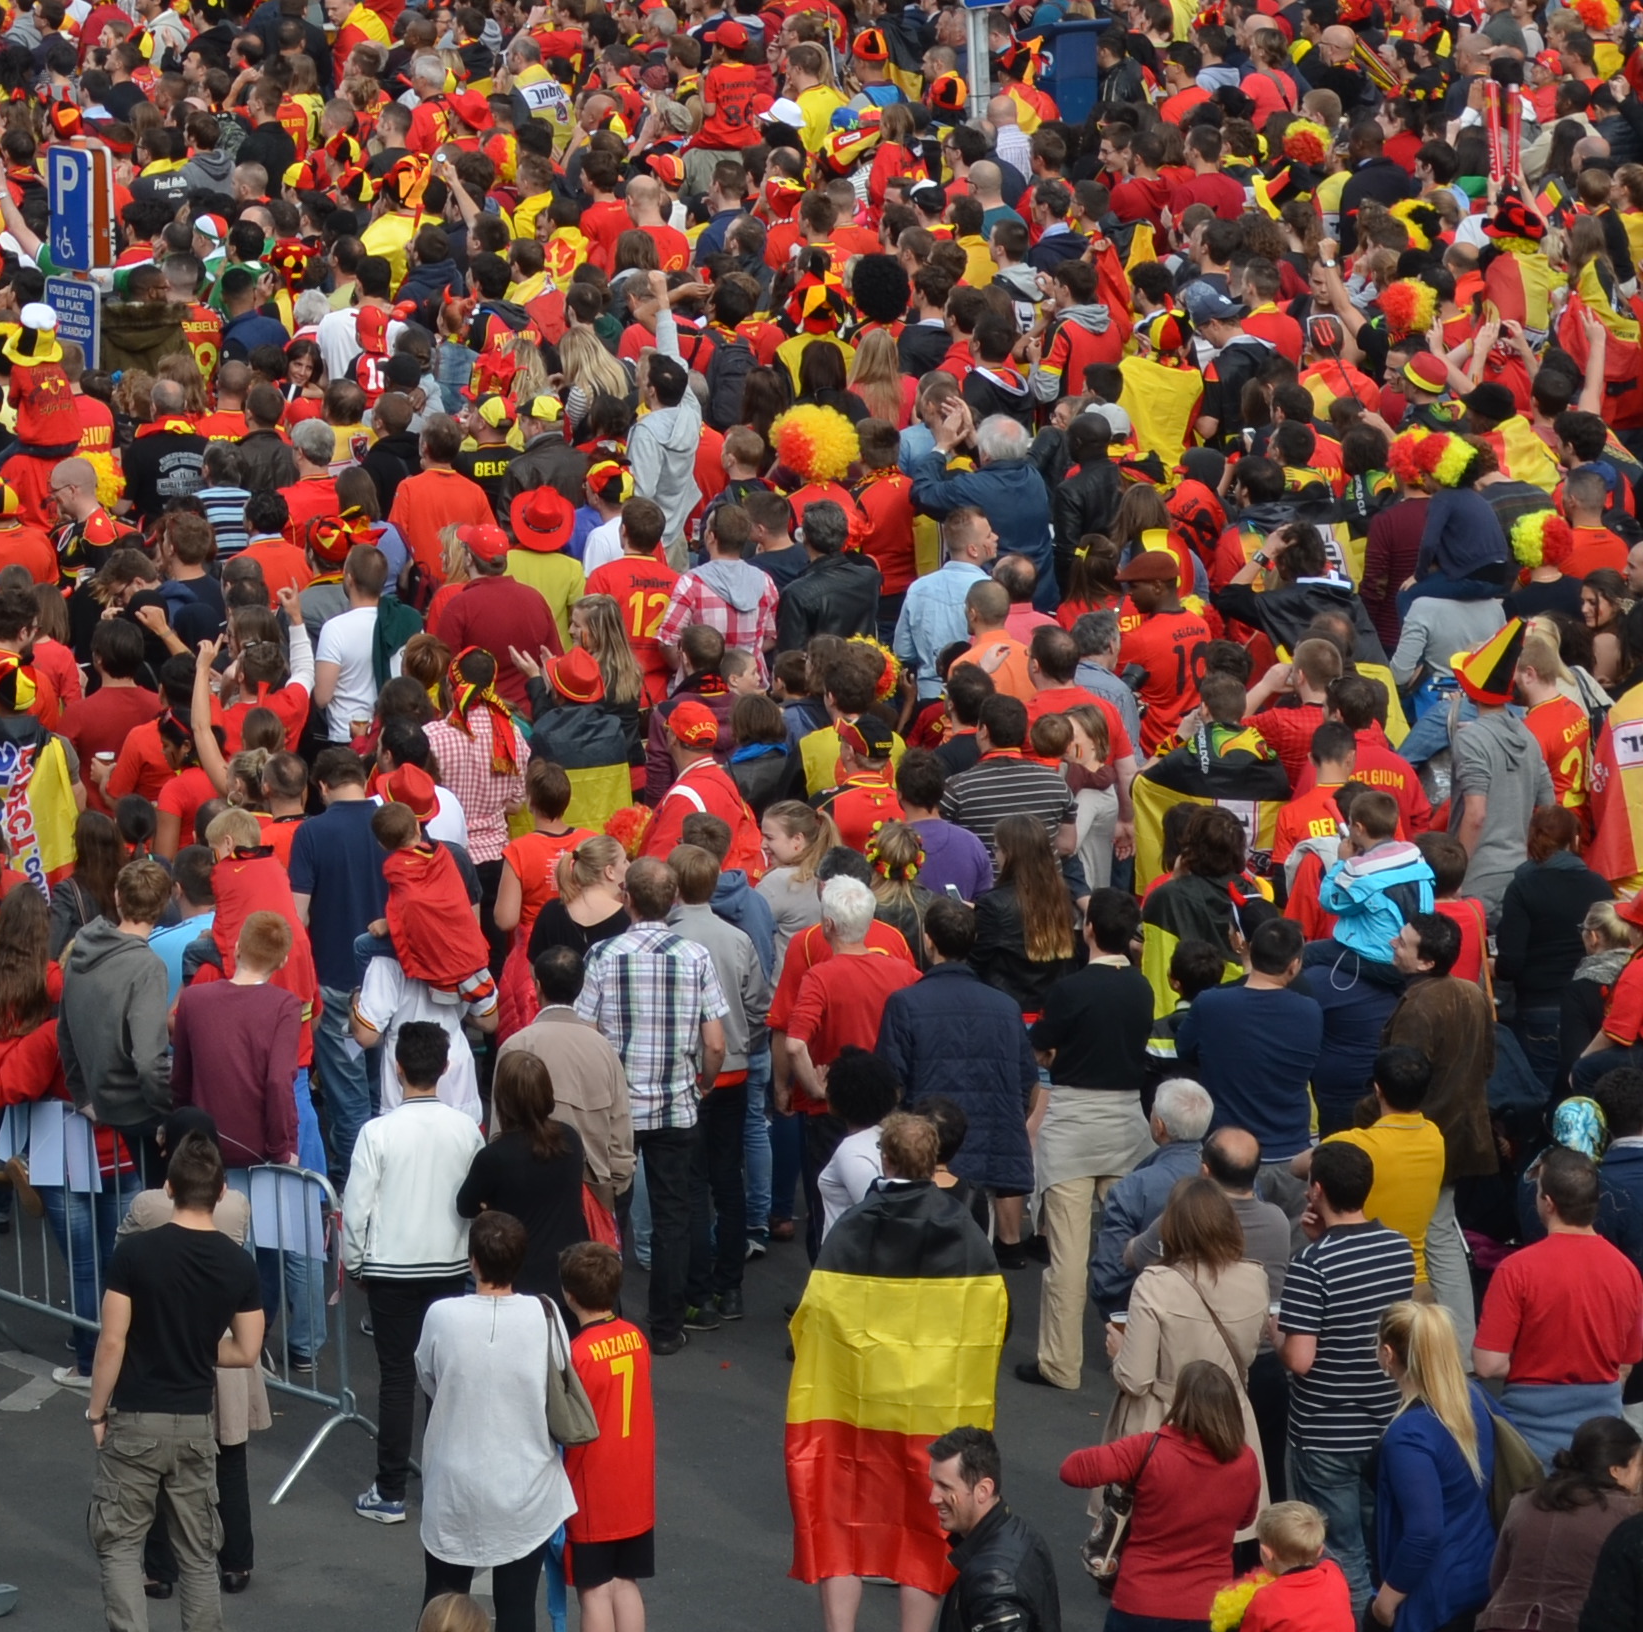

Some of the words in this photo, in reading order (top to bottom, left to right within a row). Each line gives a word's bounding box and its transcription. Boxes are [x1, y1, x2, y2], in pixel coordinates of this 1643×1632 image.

[56, 154, 79, 216] P
[49, 284, 64, 295] VOUS
[65, 287, 79, 299] AVEZ
[74, 313, 90, 325] AUSSI
[628, 590, 672, 636] 12
[588, 1330, 642, 1362] HAZARD
[610, 1354, 634, 1438] 7
